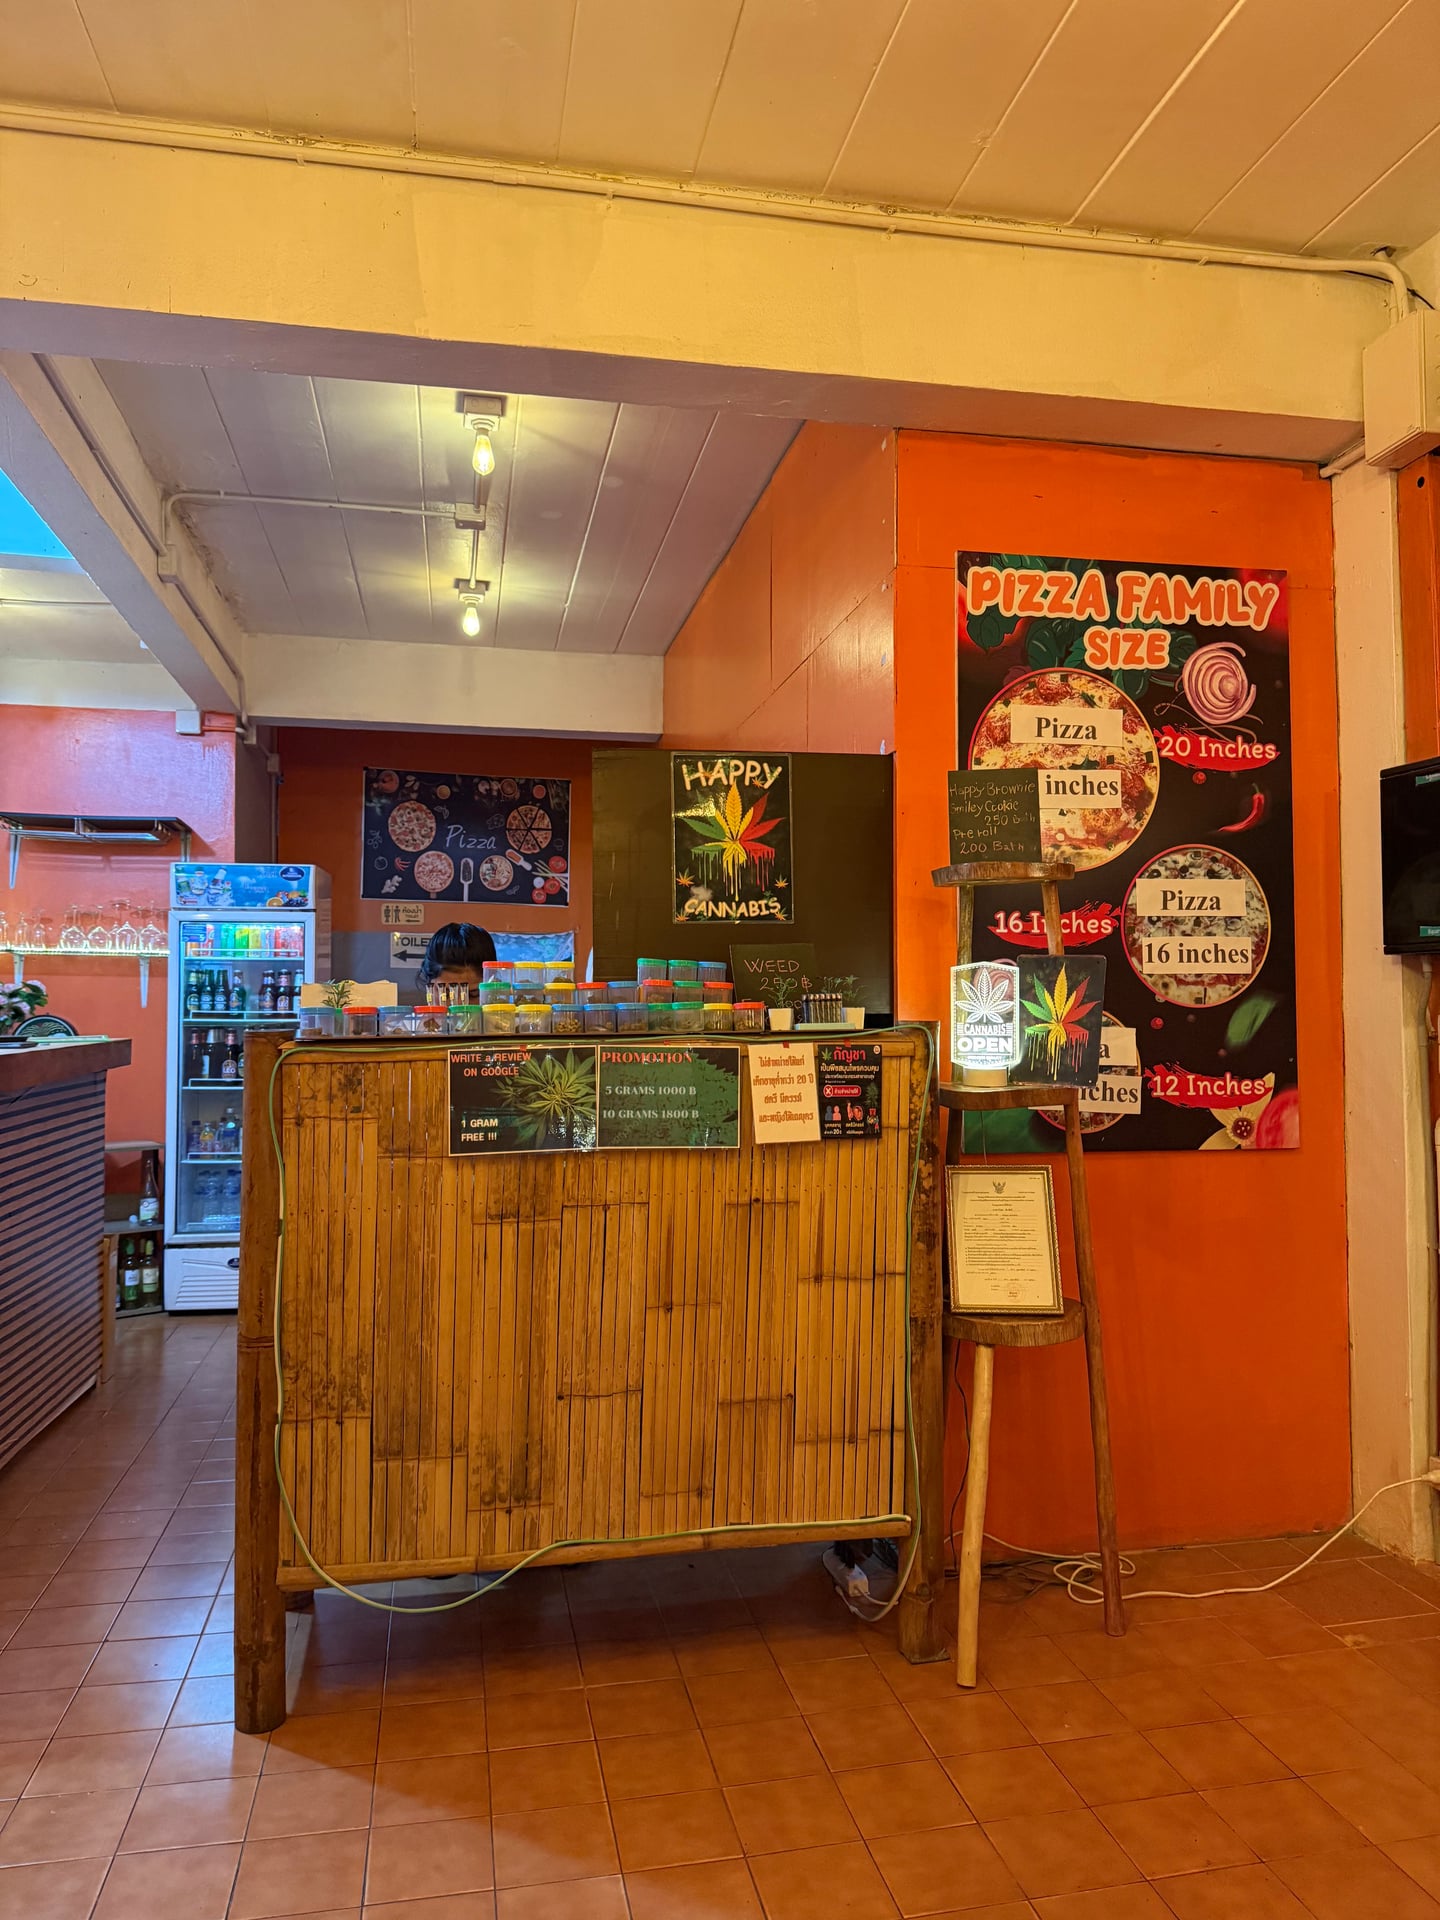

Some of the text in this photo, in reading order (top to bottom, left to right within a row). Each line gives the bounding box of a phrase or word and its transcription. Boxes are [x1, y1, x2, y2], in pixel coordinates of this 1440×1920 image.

[967, 566, 1280, 631] PIZZA FAMILY
[1083, 626, 1171, 670] SIZE
[1035, 717, 1097, 740] Pizza
[1160, 736, 1276, 759] 20 Inches
[682, 760, 783, 790] HAPPY
[949, 781, 1035, 800] Happy Brownie
[1045, 775, 1118, 796] inches
[951, 799, 1019, 817] Smiley Cookie
[985, 814, 1009, 826] 250
[445, 824, 497, 849] Pizza
[960, 842, 987, 855] 200
[684, 897, 781, 918] CANNABIS
[1160, 890, 1221, 911] Pizza
[995, 912, 1023, 933] 16
[1145, 942, 1249, 964] 16 inches
[744, 959, 800, 973] WEED
[964, 1023, 1006, 1034] CANNABIS
[957, 1037, 1013, 1052] OPEN
[451, 1054, 481, 1063] WRITE
[494, 1053, 532, 1062] REVIEW
[601, 1052, 692, 1064] PROMOTION
[833, 1046, 866, 1063] กัญชา
[463, 1067, 519, 1077] ON GOOGLE
[797, 1075, 808, 1085] 20
[605, 1086, 697, 1095] 5 GRAMS 1000 B
[1152, 1074, 1266, 1096] 12 Inches
[603, 1109, 699, 1119] 10 GRAMS 1800 B
[461, 1119, 499, 1128] 1 GRAM
[461, 1133, 485, 1142] FREE
